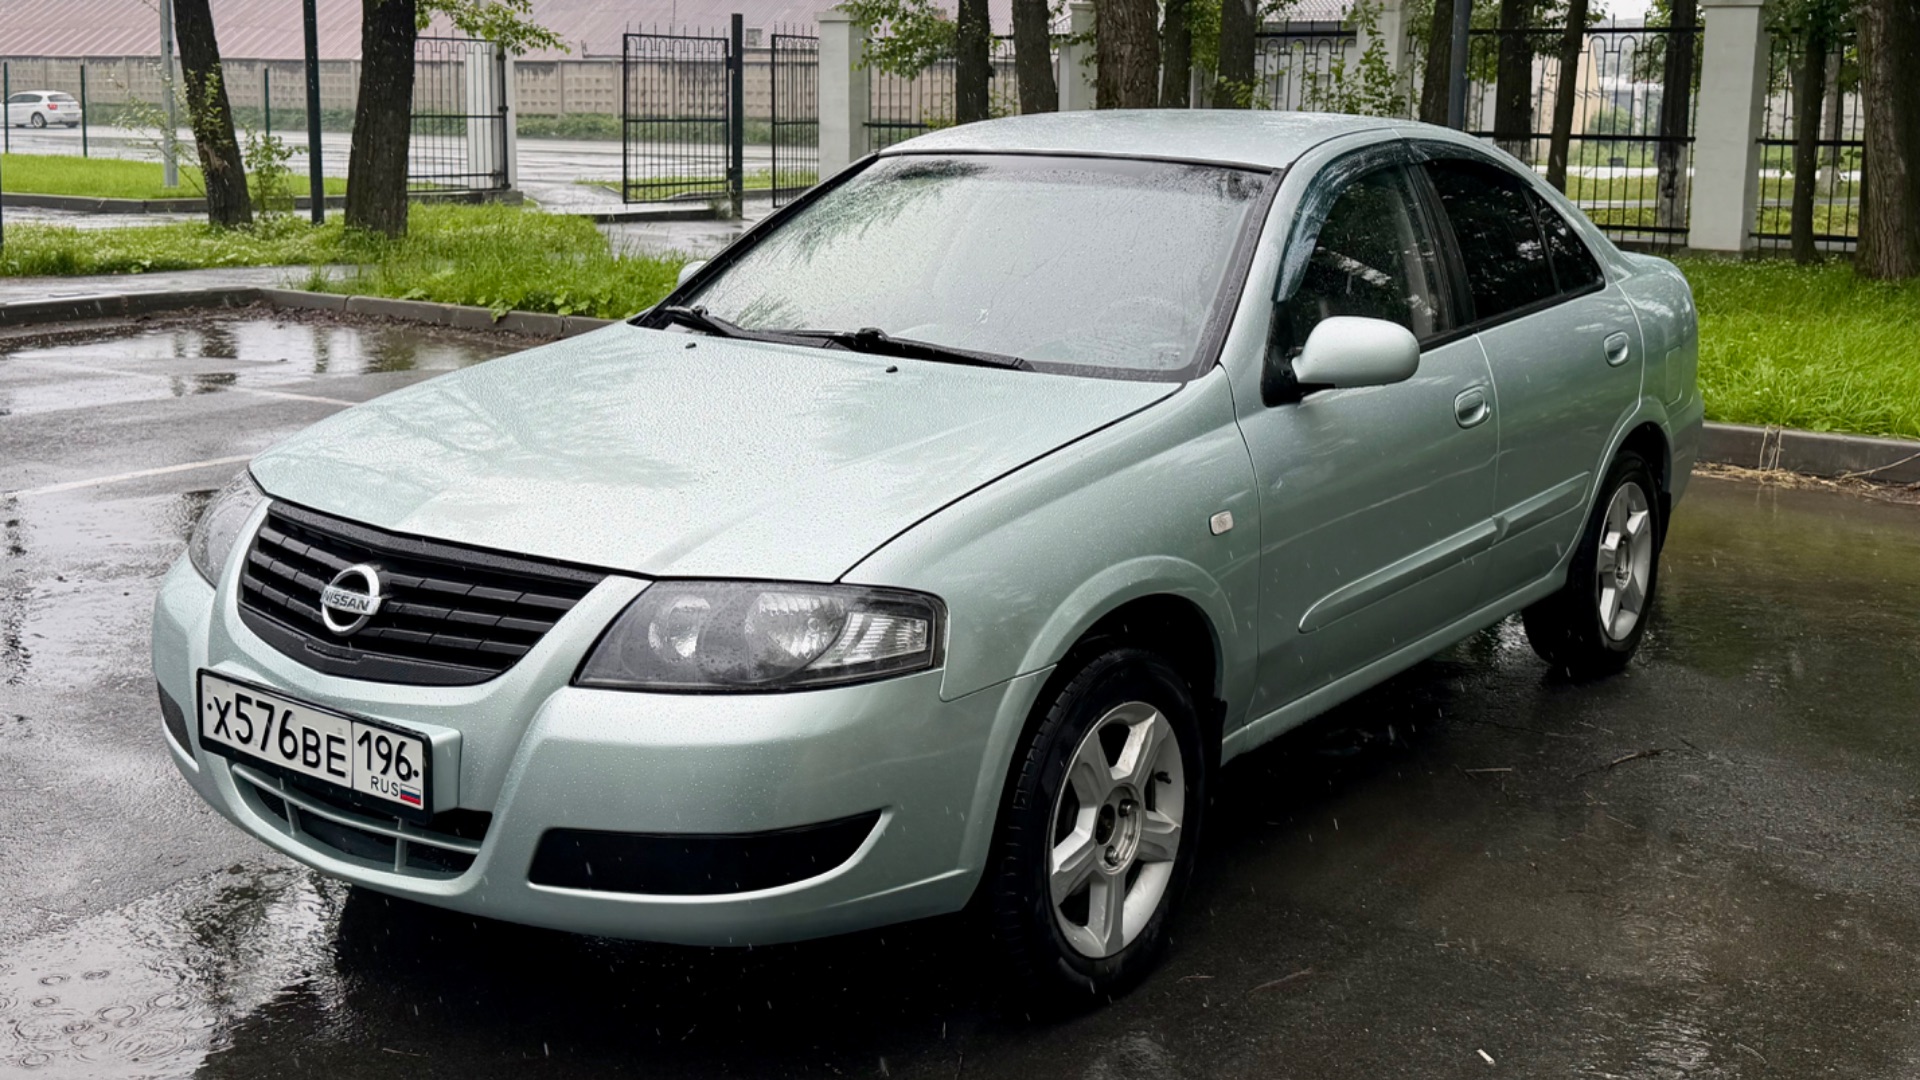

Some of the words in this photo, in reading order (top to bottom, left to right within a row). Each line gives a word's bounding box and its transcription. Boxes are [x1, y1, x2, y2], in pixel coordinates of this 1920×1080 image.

[323, 590, 370, 611] NISSAN
[213, 692, 346, 778] Х576ВЕ
[357, 730, 412, 781] 196
[370, 775, 399, 797] RUS
